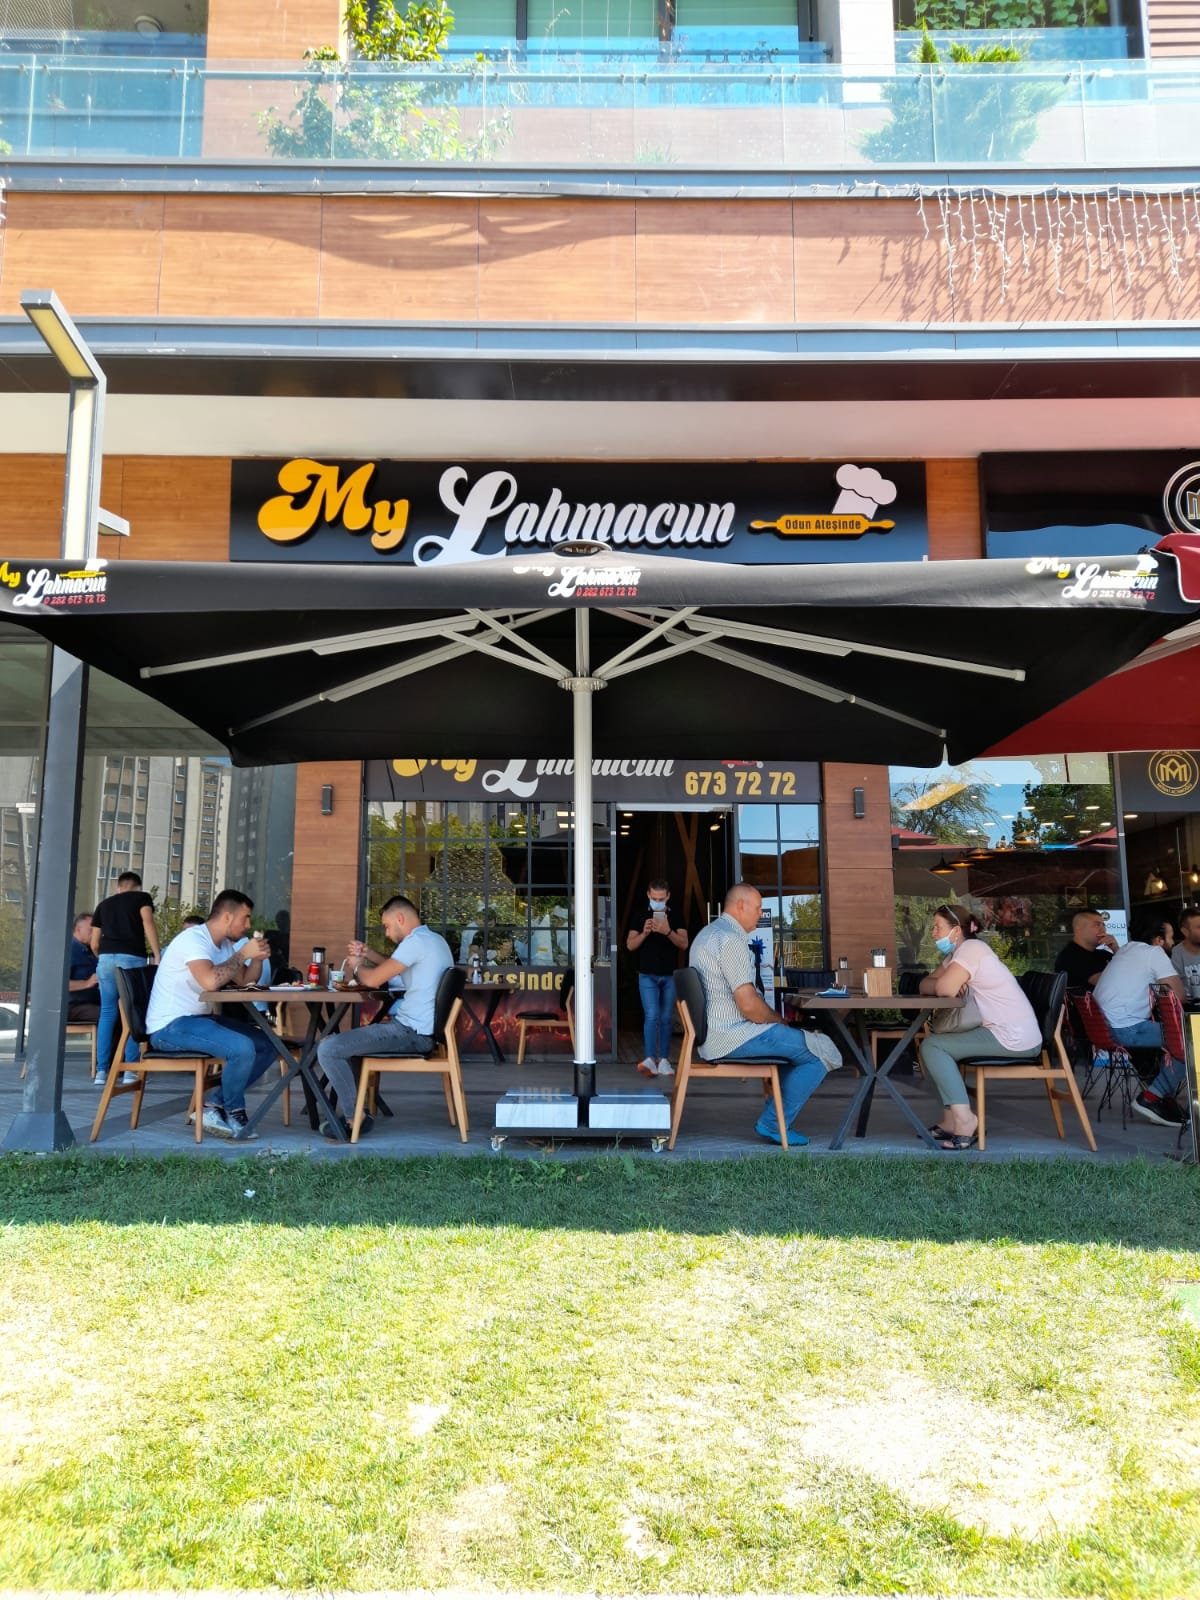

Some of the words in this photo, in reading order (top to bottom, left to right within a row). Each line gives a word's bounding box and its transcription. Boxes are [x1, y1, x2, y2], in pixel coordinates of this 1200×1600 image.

[257, 458, 410, 550] My
[413, 465, 735, 567] Lahmacun
[785, 519, 811, 530] Odun
[815, 519, 861, 531] Ateşinde
[12, 569, 107, 606] Lahmacun
[1145, 591, 1155, 600] 72
[685, 771, 727, 795] 673
[734, 771, 762, 795] 72
[768, 771, 796, 795] 72
